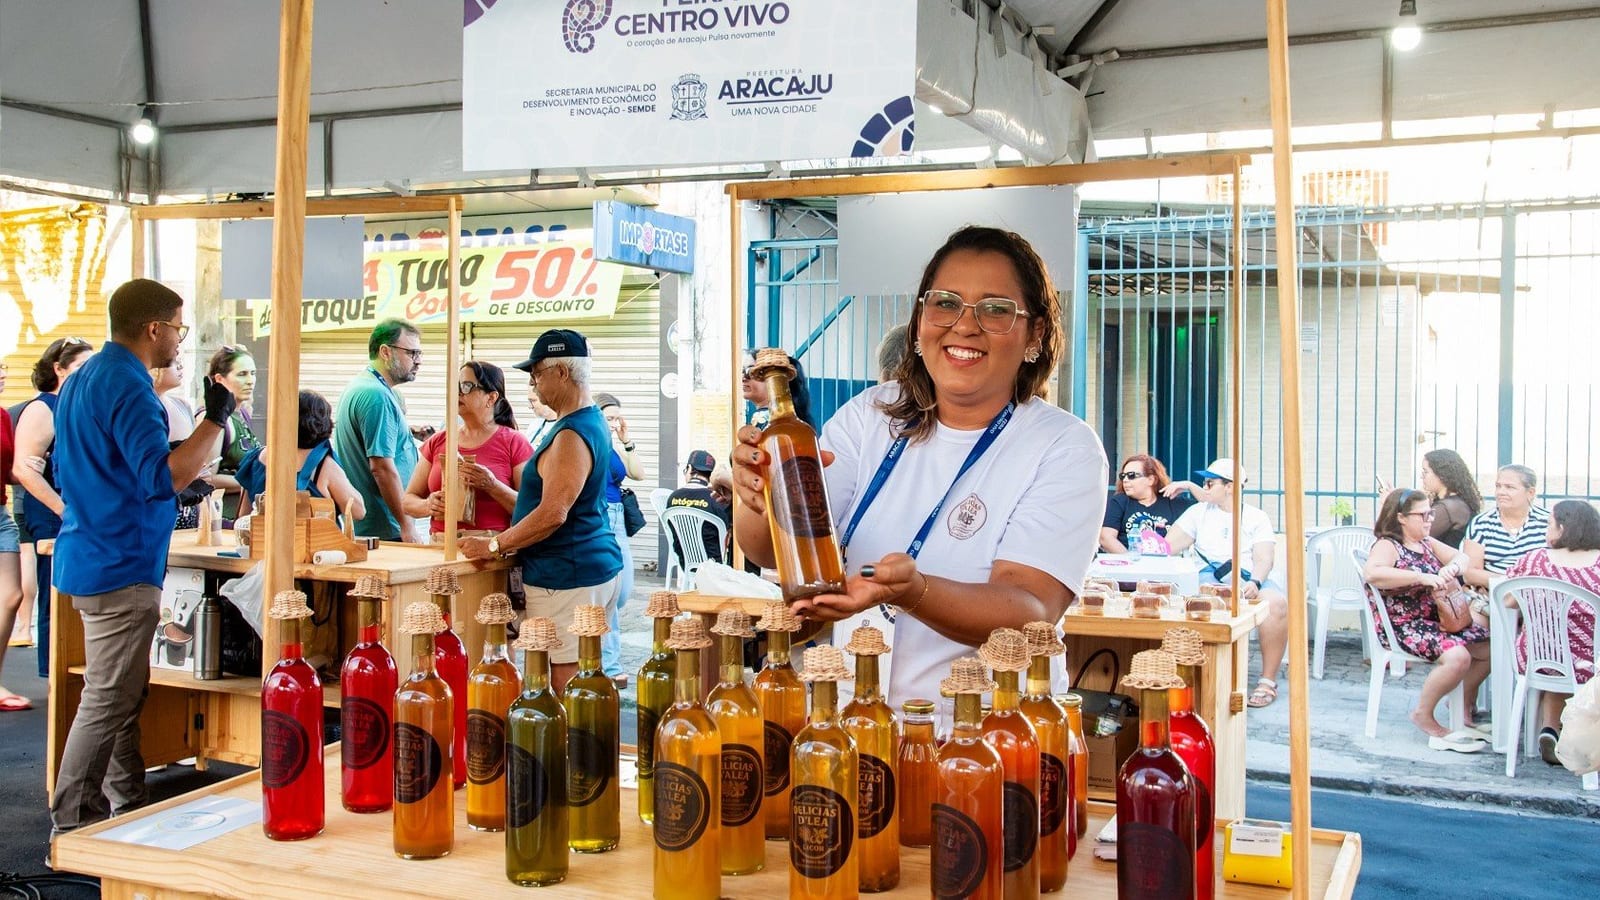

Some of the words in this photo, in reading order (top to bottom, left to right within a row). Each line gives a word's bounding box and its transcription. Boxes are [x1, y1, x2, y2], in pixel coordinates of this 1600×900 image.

[614, 8, 719, 36] CENTRO
[724, 2, 790, 28] VIVO
[634, 38, 665, 48] coração
[666, 37, 676, 45] de
[677, 35, 707, 46] Aracaju
[708, 33, 729, 42] Pulsa
[730, 30, 776, 39] novamente
[746, 69, 804, 77] PREFEITURA
[545, 87, 594, 97] SECRETARIA
[595, 84, 641, 95] MUNICIPAL
[643, 83, 656, 92] DO
[718, 74, 833, 100] ARACAJU
[523, 97, 600, 109] DESENVOLVIMENTO
[601, 93, 656, 104] ECONÔMICO
[570, 108, 575, 116] E
[576, 105, 620, 116] INOVAÇÃO
[627, 104, 657, 113] SEMDE
[731, 108, 751, 117] UMA
[754, 106, 780, 116] NOVA
[782, 104, 817, 114] CIDADE
[490, 247, 598, 300] 50%
[302, 295, 377, 326] TOQUE
[516, 299, 594, 315] DESCONTO
